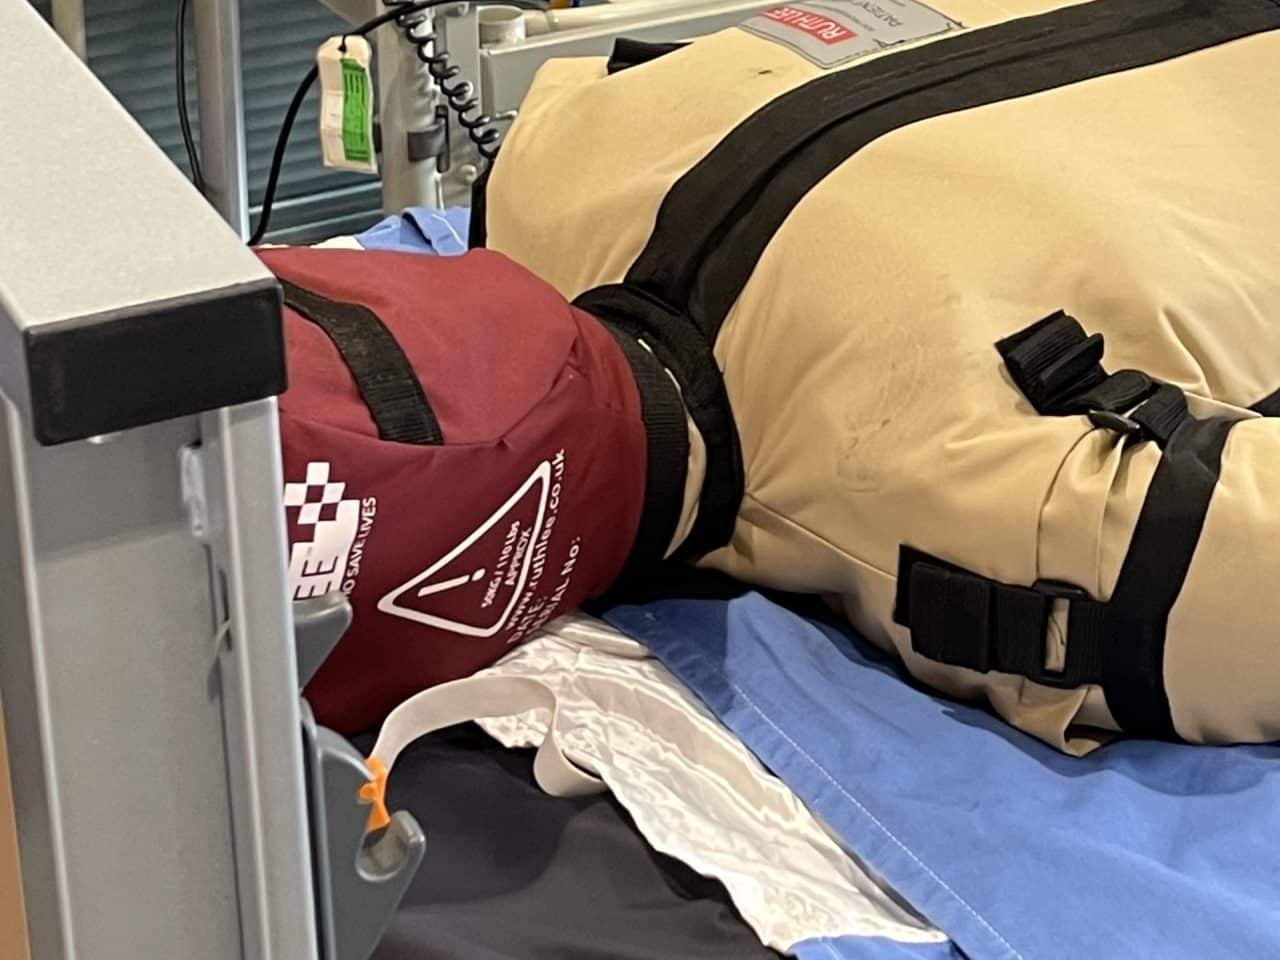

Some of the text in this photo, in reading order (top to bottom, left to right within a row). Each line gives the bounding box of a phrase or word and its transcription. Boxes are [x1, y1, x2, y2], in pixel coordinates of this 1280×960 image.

[346, 539, 367, 578] SAVE
[357, 497, 377, 539] LIVES
[505, 448, 565, 631] www.ruthlee.co.uk
